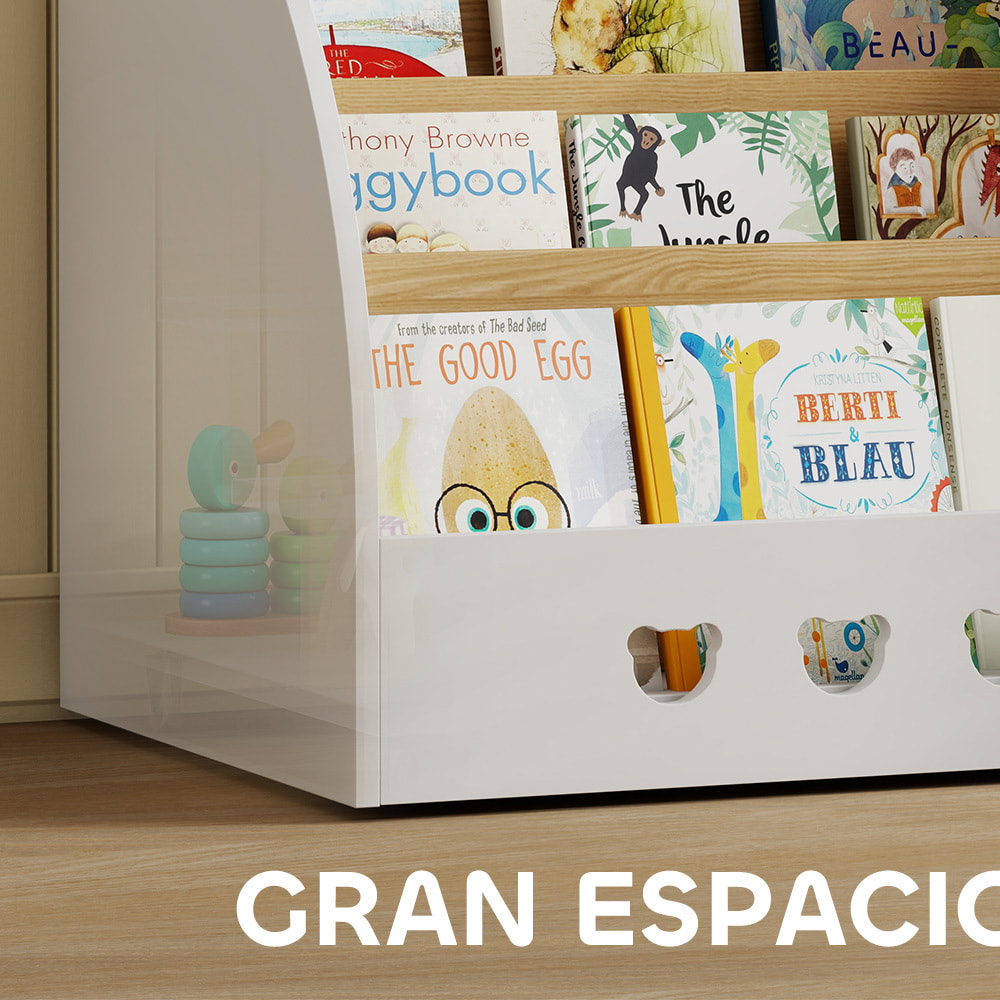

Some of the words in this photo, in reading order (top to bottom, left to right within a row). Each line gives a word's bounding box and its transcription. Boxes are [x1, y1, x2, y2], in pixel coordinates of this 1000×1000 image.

[329, 49, 349, 57] THE
[427, 126, 530, 149] Browne
[568, 139, 577, 169] The
[571, 174, 584, 231] Jungle
[676, 179, 735, 217] The
[397, 323, 419, 336] From
[422, 322, 436, 336] the
[439, 321, 475, 335] creators
[478, 320, 486, 334] of
[490, 318, 505, 334] The
[508, 318, 524, 333] Bad
[527, 317, 547, 332] Seed
[371, 343, 422, 389] THE
[438, 340, 517, 385] GOOD
[533, 339, 592, 381] EGG
[933, 317, 947, 401] COMPLETE
[853, 372, 882, 384] LITTEN
[794, 390, 901, 423] BERTI
[849, 426, 860, 442] &
[793, 441, 915, 484] BLAU
